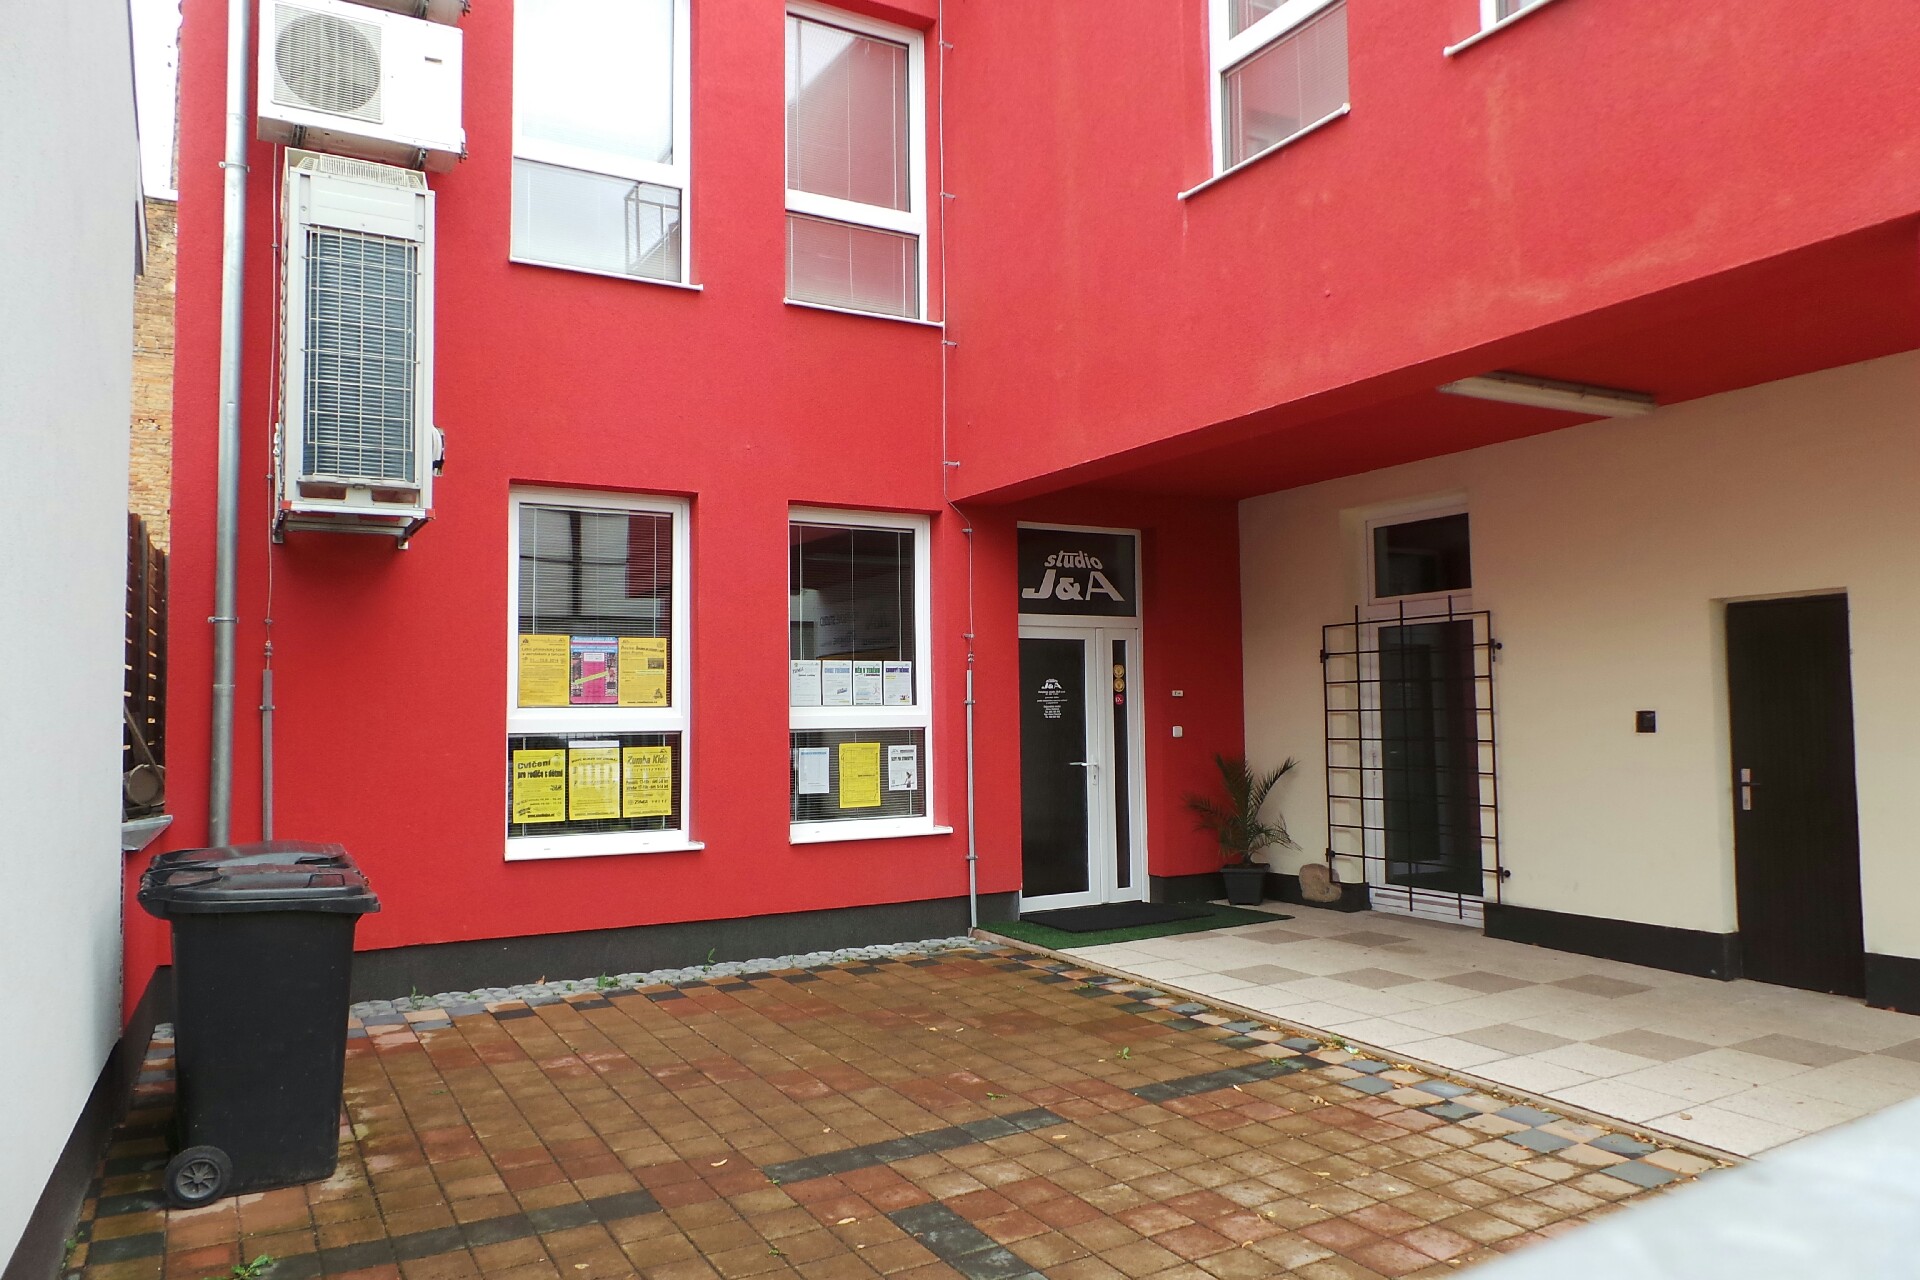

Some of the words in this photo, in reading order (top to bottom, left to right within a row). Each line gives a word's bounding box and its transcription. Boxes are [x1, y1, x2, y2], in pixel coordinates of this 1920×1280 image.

[1044, 550, 1103, 570] studio
[1021, 568, 1126, 602] J&A
[517, 759, 551, 770] Cvičení
[627, 755, 651, 765] Zumba
[652, 754, 668, 764] Kids
